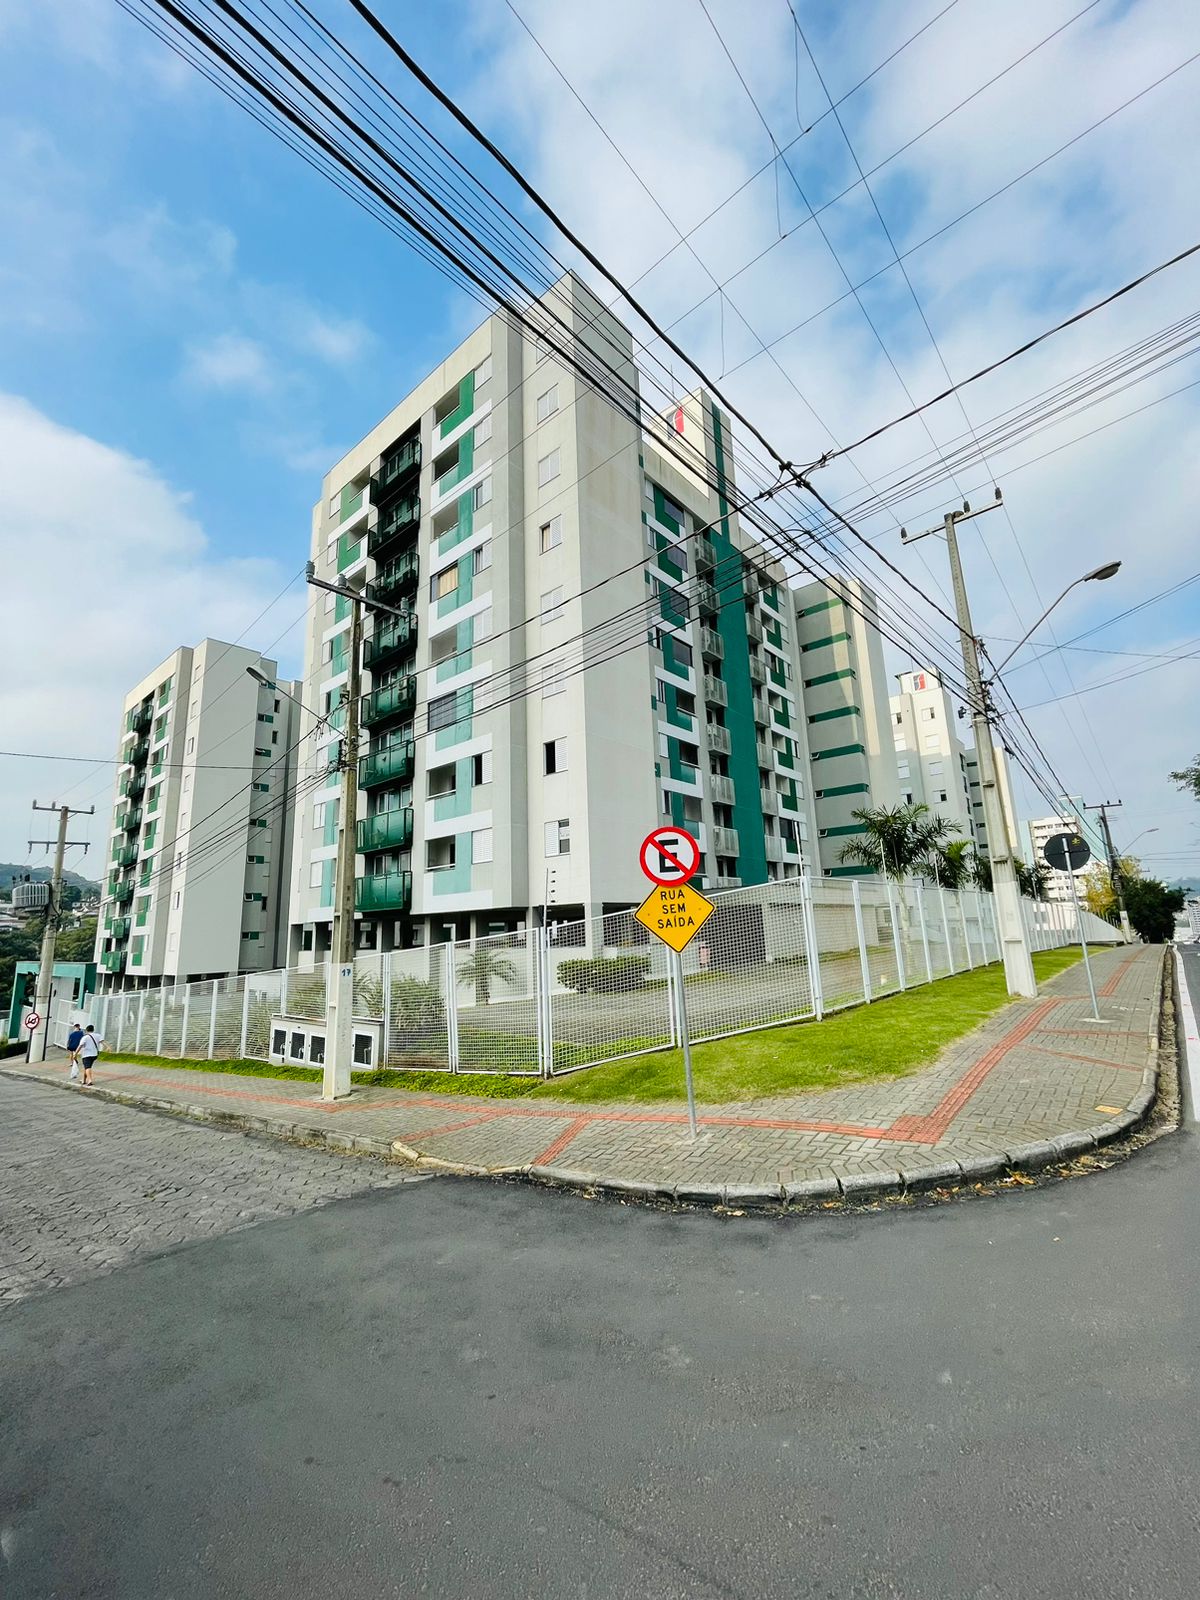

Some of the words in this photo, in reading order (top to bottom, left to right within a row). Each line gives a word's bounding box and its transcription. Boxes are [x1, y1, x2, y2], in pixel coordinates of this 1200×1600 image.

[658, 838, 680, 873] E
[660, 889, 685, 901] RUA
[662, 903, 686, 915] SEM
[657, 915, 695, 929] SAÍDA
